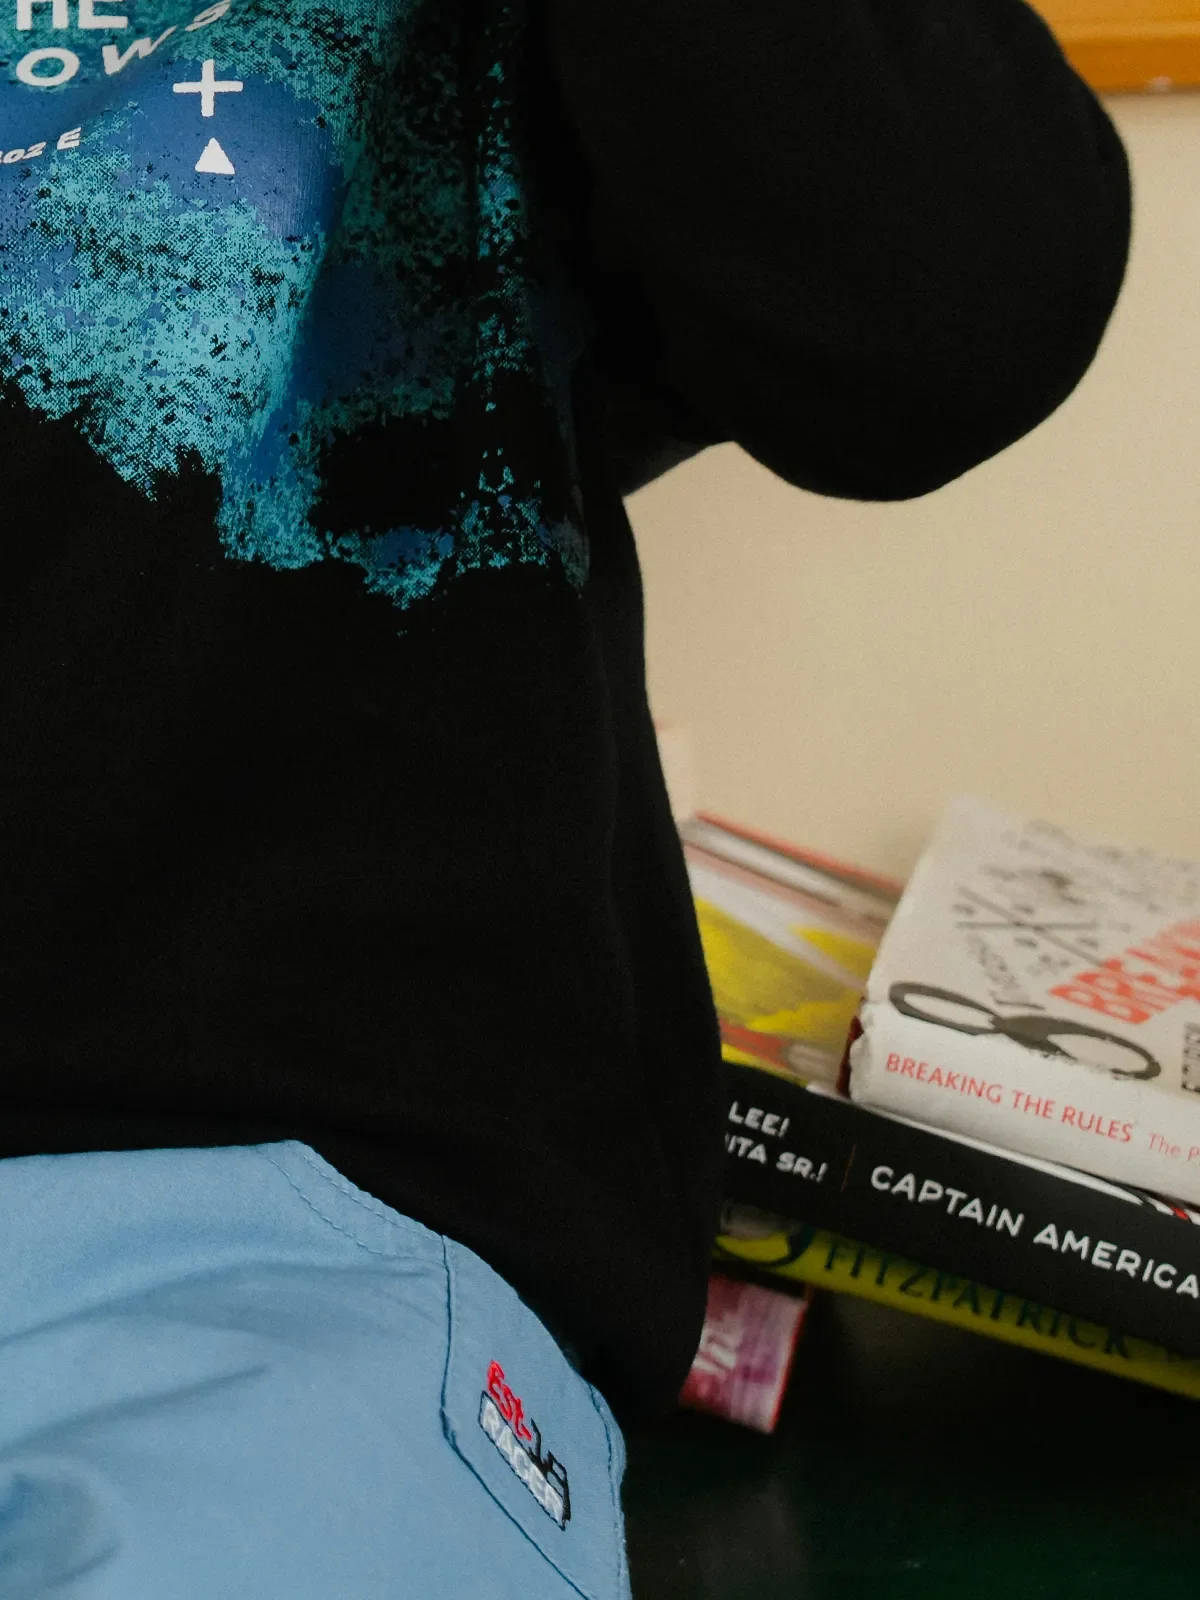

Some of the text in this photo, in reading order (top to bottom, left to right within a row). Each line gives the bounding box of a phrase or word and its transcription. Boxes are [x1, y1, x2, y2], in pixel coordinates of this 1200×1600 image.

[55, 125, 83, 151] E
[727, 1101, 791, 1138] LEE!
[884, 1050, 1004, 1106] BREAKING
[1011, 1088, 1057, 1120] THE
[1059, 1103, 1134, 1145] RULES
[1147, 1131, 1182, 1160] The
[724, 1132, 768, 1165] ITA
[869, 1164, 1200, 1299] CAPTAIN AMERICA
[823, 1238, 1131, 1358] FITZPATRICK
